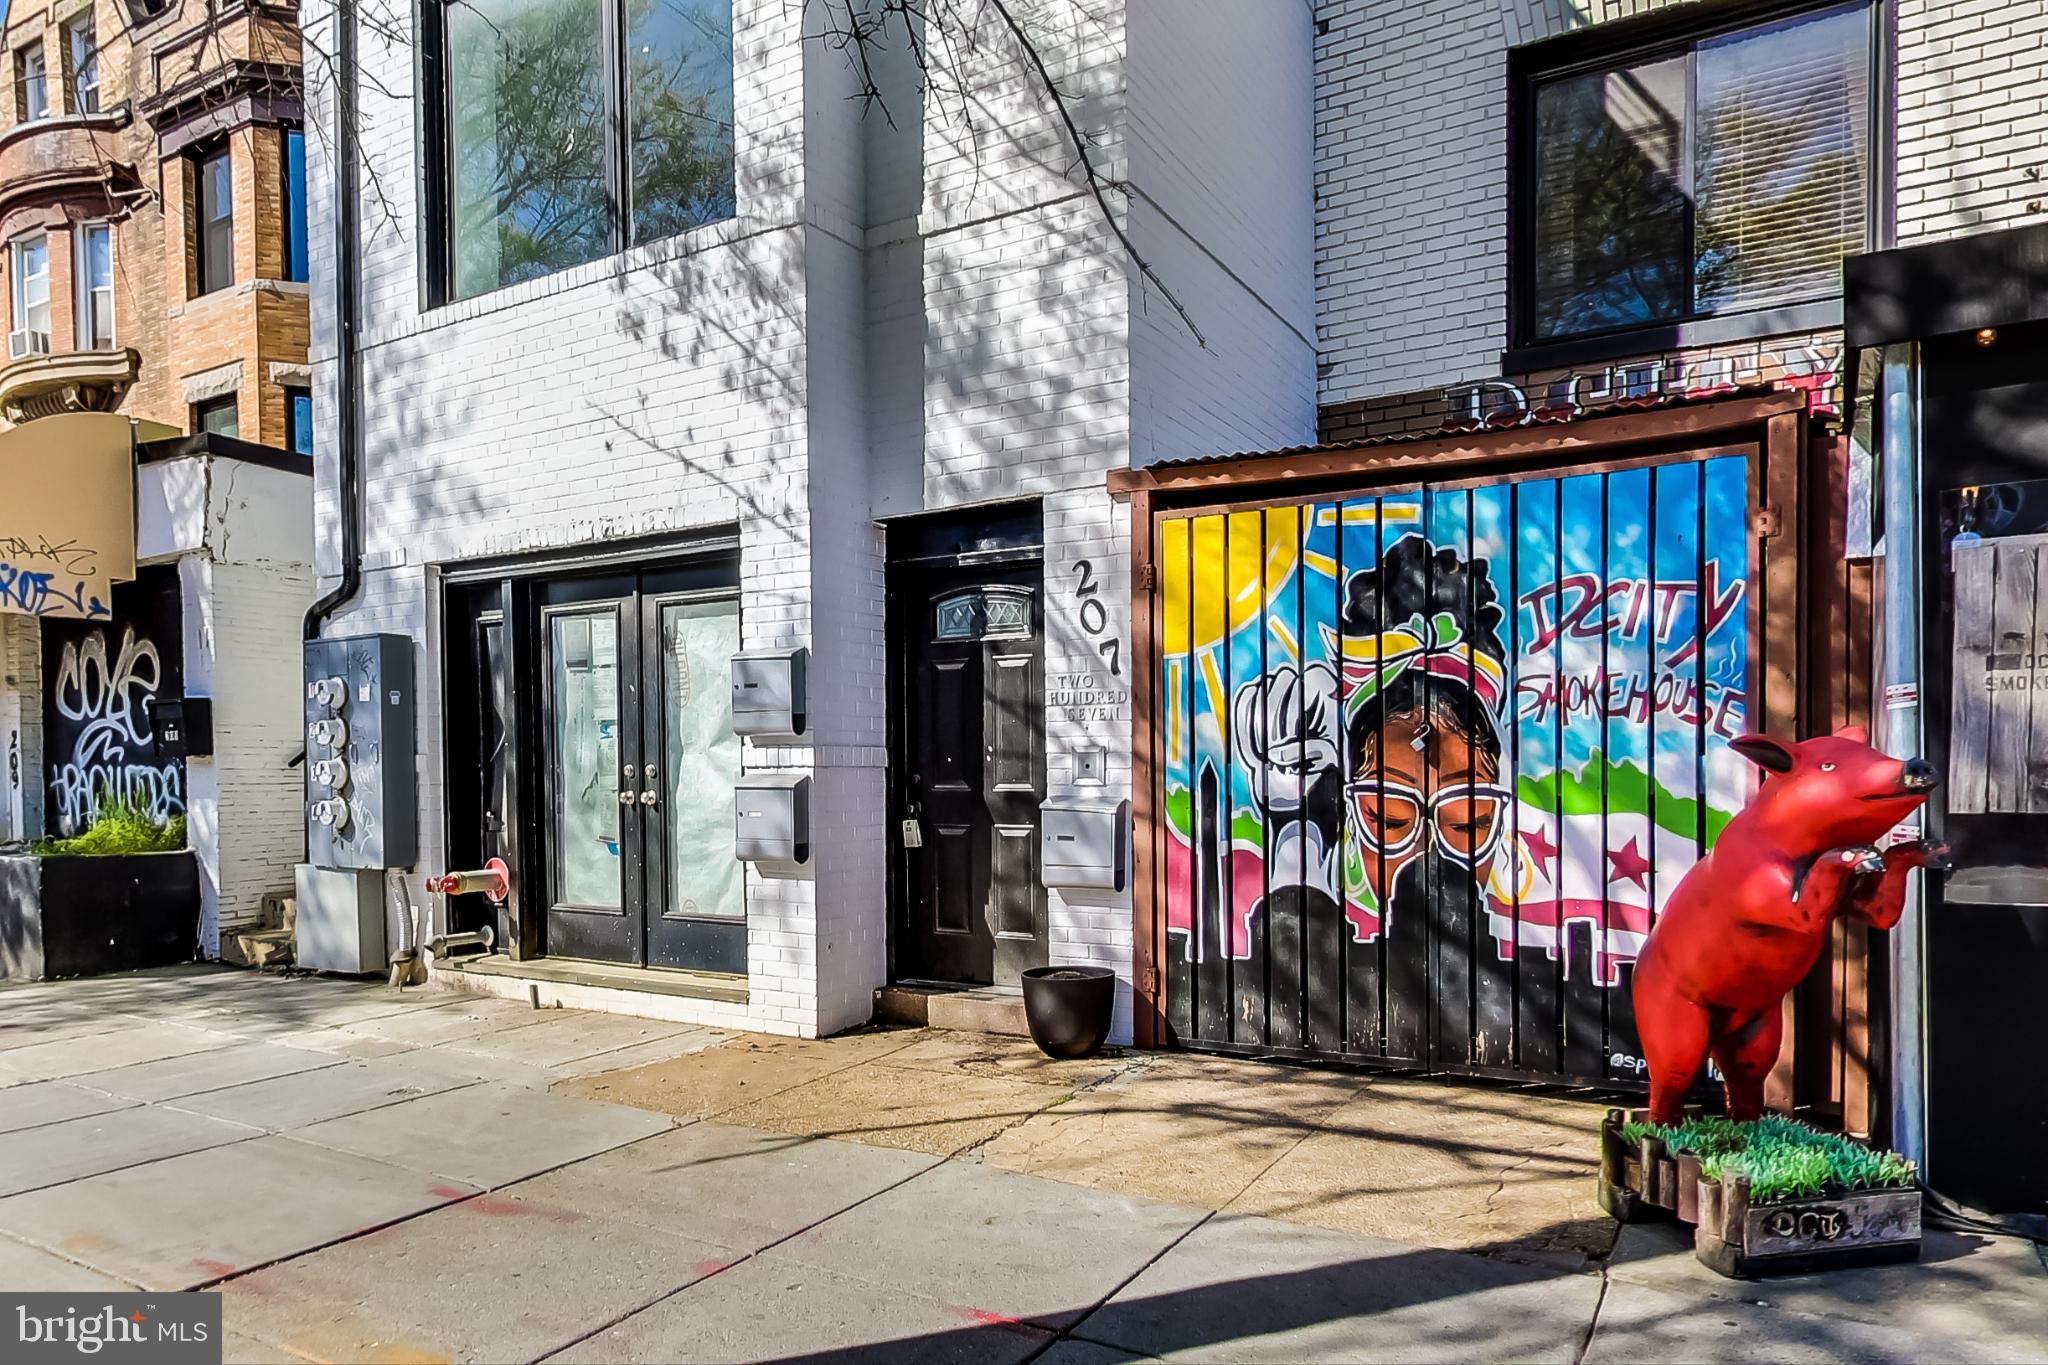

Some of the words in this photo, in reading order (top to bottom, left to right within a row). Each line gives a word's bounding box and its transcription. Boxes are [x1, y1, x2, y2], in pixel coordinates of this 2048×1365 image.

[1071, 559, 1121, 676] 207
[1519, 558, 1746, 668] DCITY
[1050, 690, 1128, 706] HUNDRED
[1058, 675, 1094, 689] TWO
[1505, 665, 1746, 738] SMOKEHOUSE
[1067, 707, 1120, 722] SEVEN
